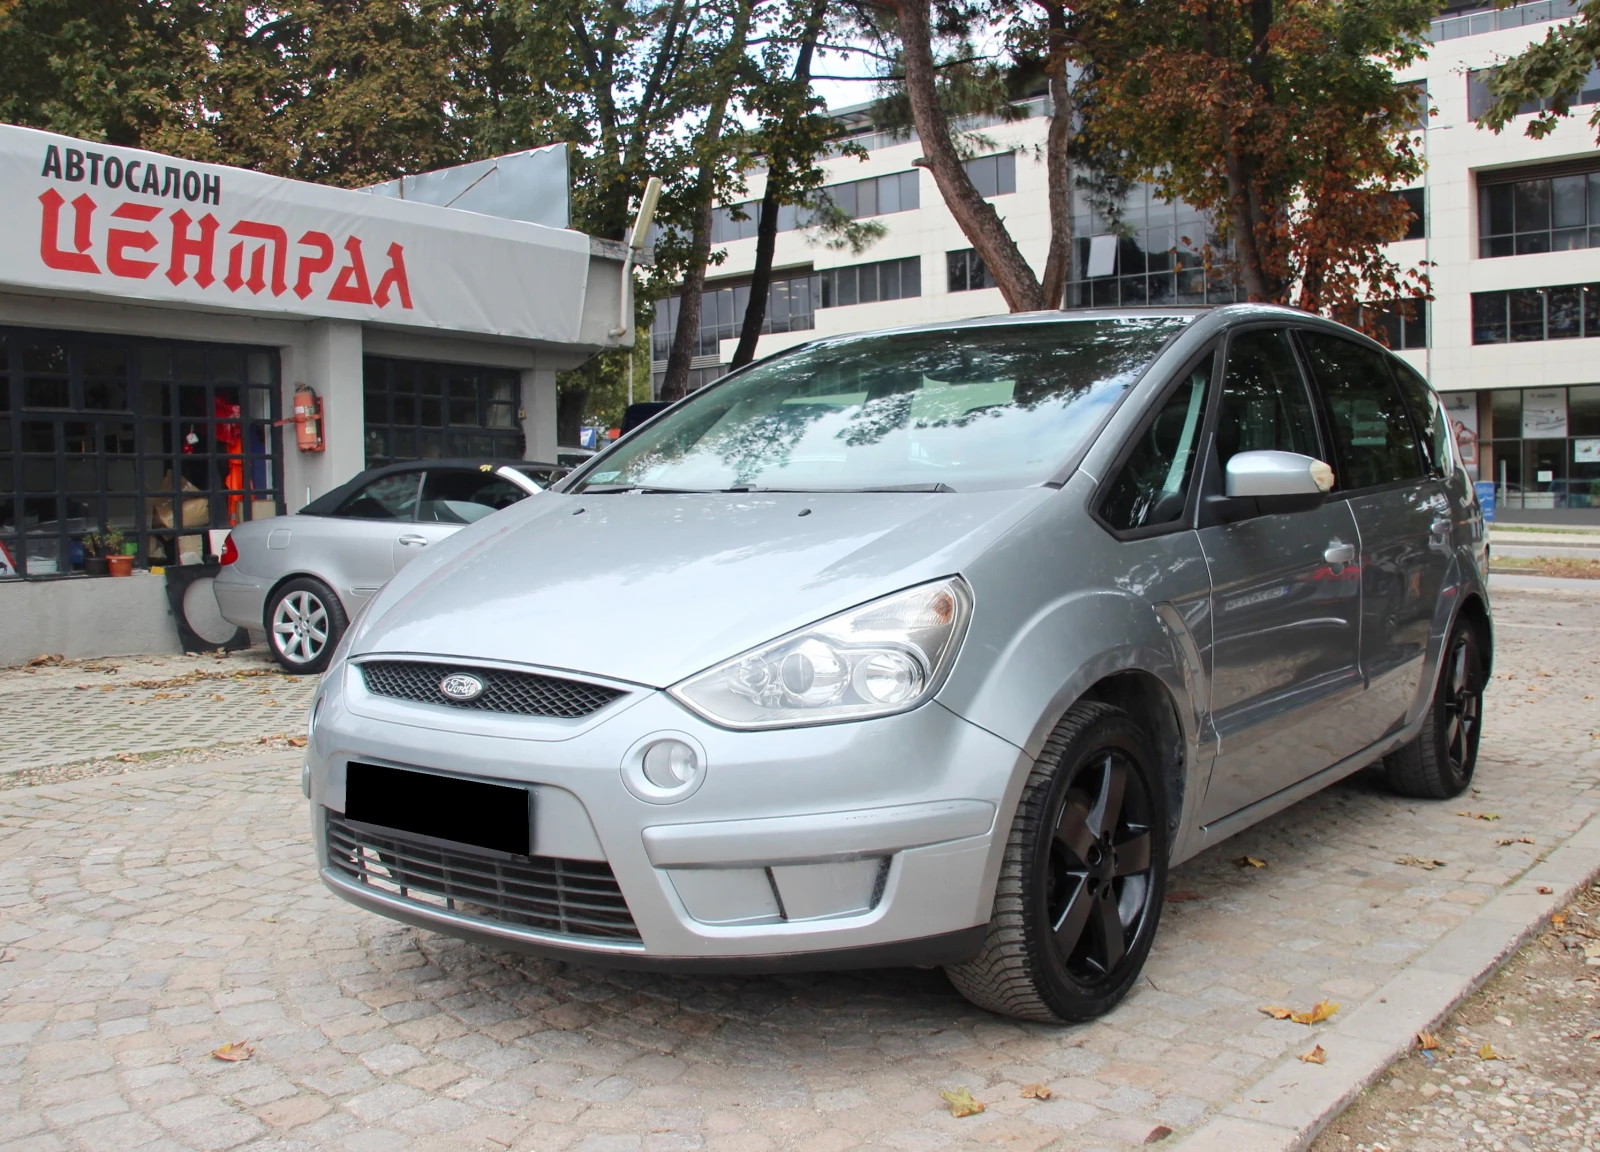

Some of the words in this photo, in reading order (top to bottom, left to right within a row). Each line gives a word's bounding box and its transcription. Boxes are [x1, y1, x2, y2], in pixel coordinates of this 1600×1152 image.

[42, 144, 222, 206] АВТОСАЛОН
[37, 187, 414, 310] ЦЕНТРАЛ
[444, 677, 478, 697] Ford
